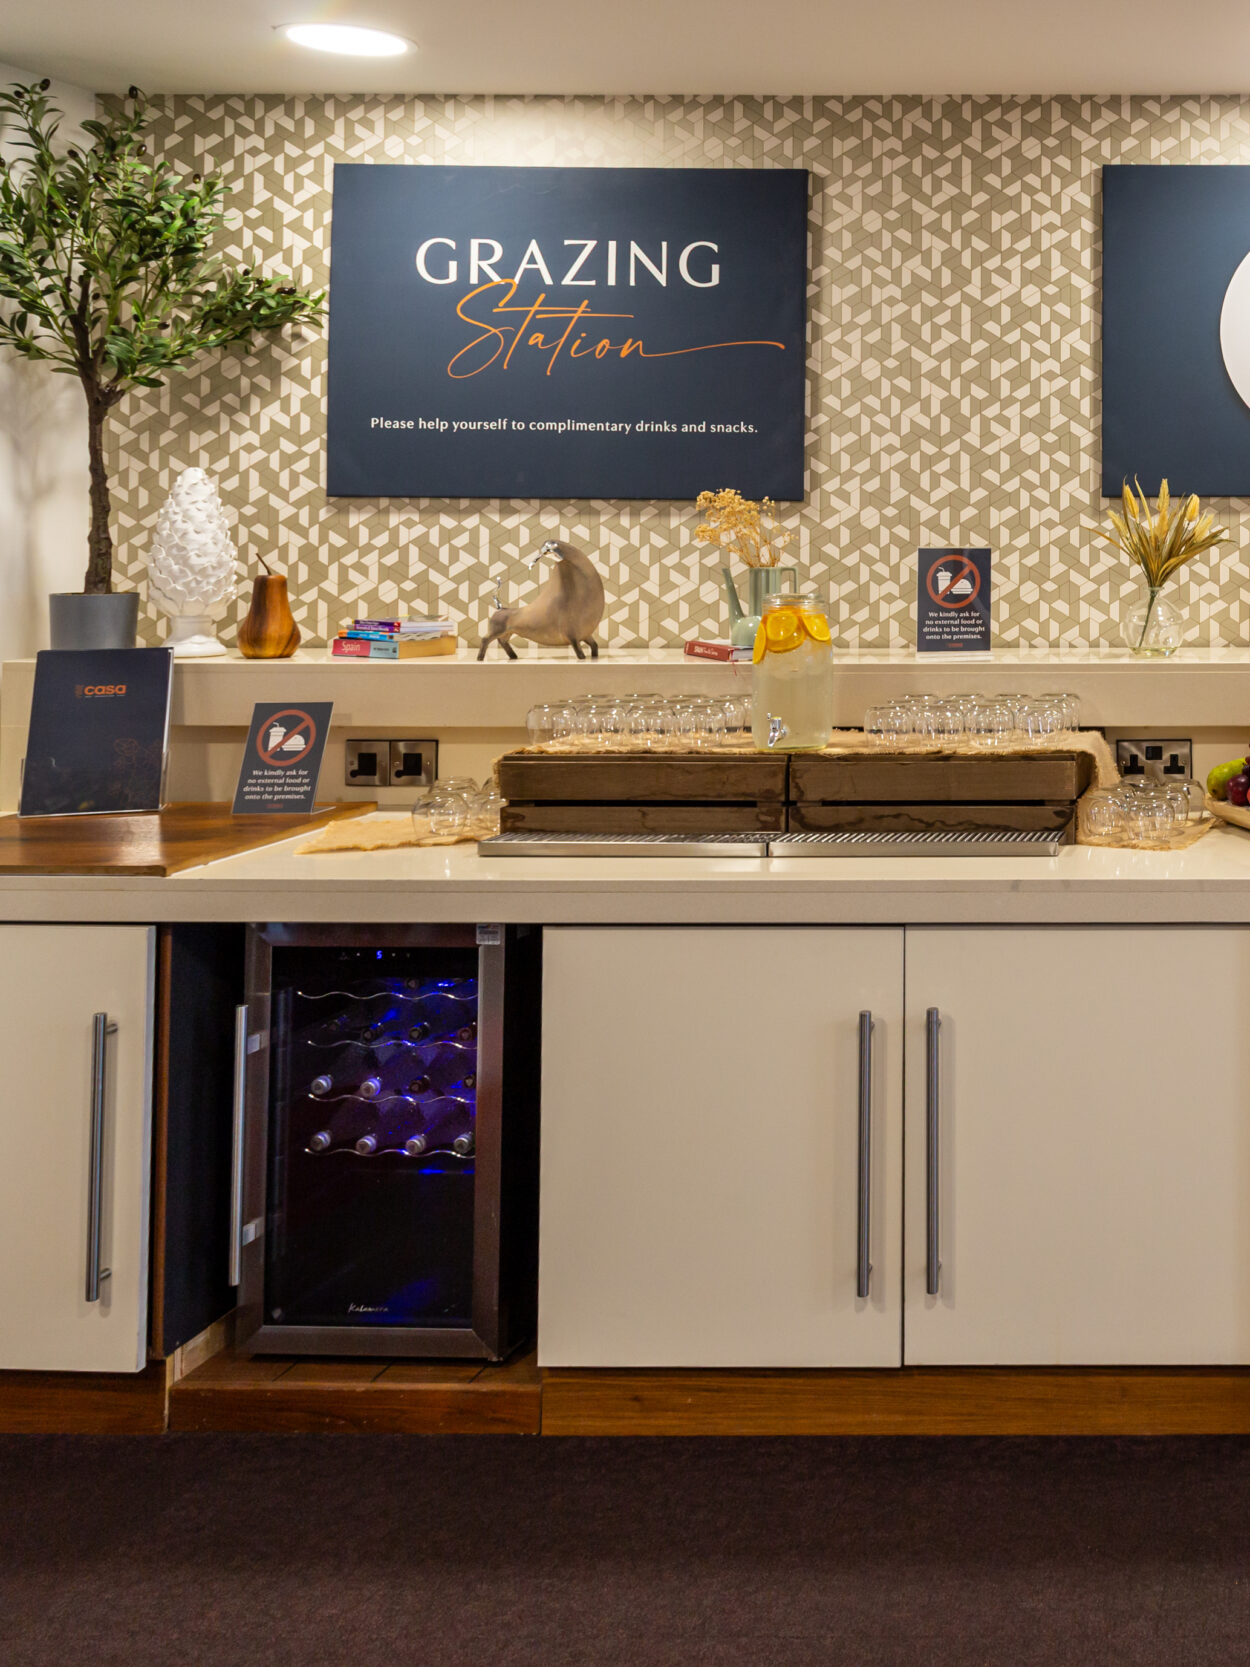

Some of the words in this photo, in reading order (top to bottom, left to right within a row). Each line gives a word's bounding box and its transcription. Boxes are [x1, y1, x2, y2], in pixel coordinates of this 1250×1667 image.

[415, 236, 720, 288] GRAZING
[447, 278, 786, 379] Station
[370, 416, 415, 430] Please
[418, 417, 449, 434] help
[452, 418, 508, 434] yourself
[511, 420, 526, 431] to
[528, 419, 632, 436] complimentary
[635, 420, 678, 433] drinks
[681, 421, 706, 434] and
[710, 421, 758, 434] snacks.
[341, 641, 360, 654] Spain
[84, 684, 128, 696] casa
[264, 769, 284, 777] kindly
[284, 785, 312, 793] brought
[274, 793, 306, 801] premises.
